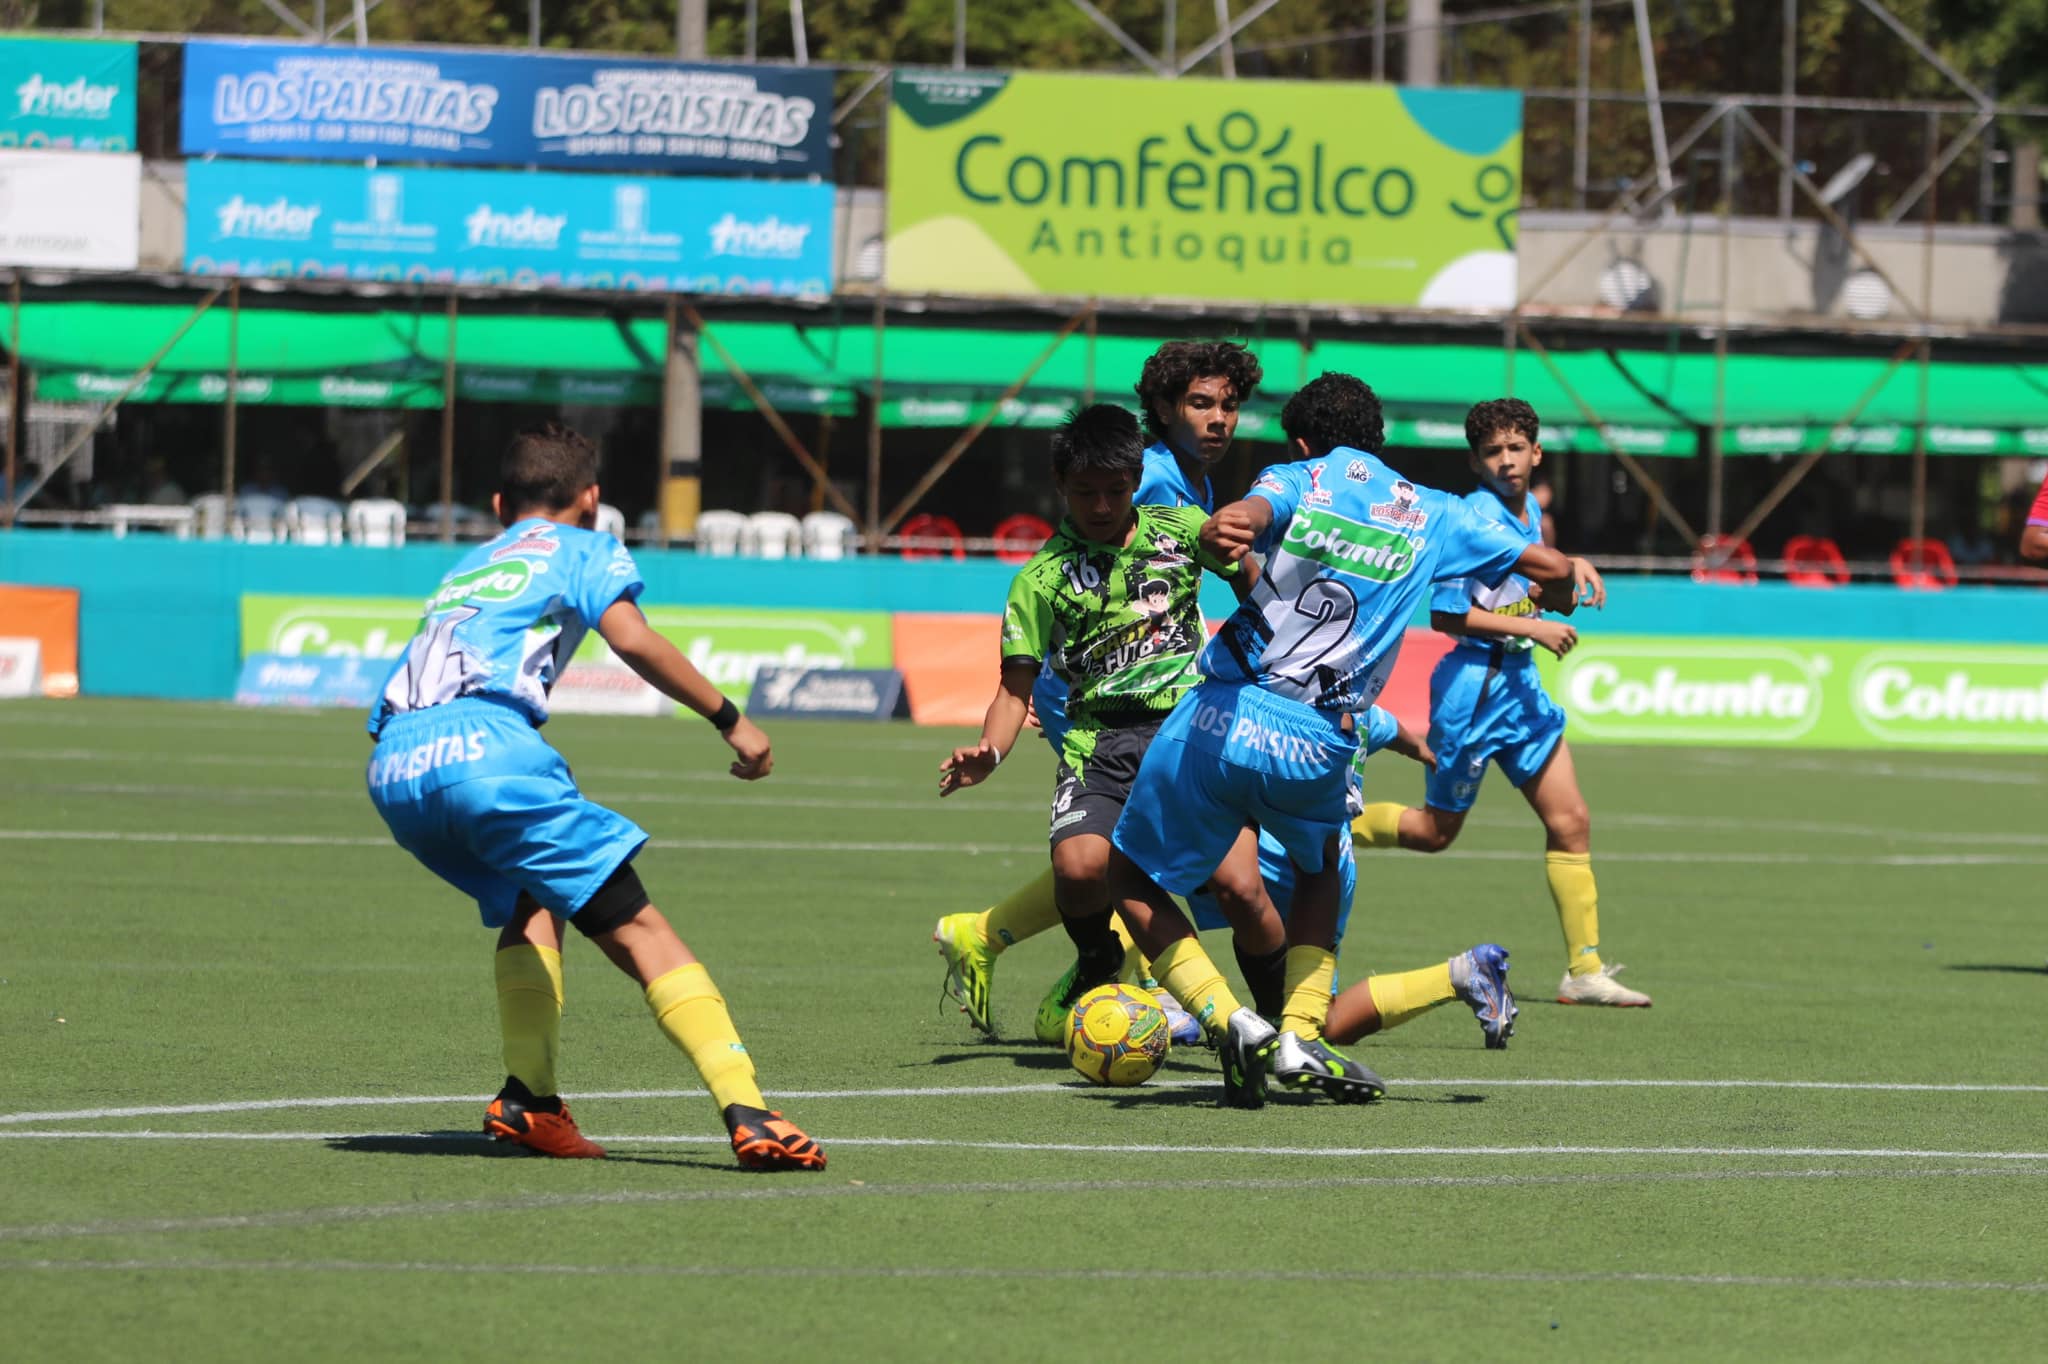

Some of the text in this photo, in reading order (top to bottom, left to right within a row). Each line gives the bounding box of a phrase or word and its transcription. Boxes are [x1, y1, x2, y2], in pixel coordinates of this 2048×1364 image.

[215, 73, 499, 134] LOS PAISITAS
[533, 84, 815, 147] LOS PAISITAS
[955, 134, 1417, 217] Comfenalco
[1029, 219, 1352, 272] Antioquia
[1346, 471, 1367, 482] JMG
[1287, 513, 1408, 572] Colanta
[1061, 552, 1100, 596] 16
[1265, 577, 1358, 688] 2
[1568, 660, 1810, 718] Colanta
[1862, 665, 2048, 724] Colan
[1190, 702, 1234, 738] LOS
[1230, 717, 1330, 764] PAISITAS
